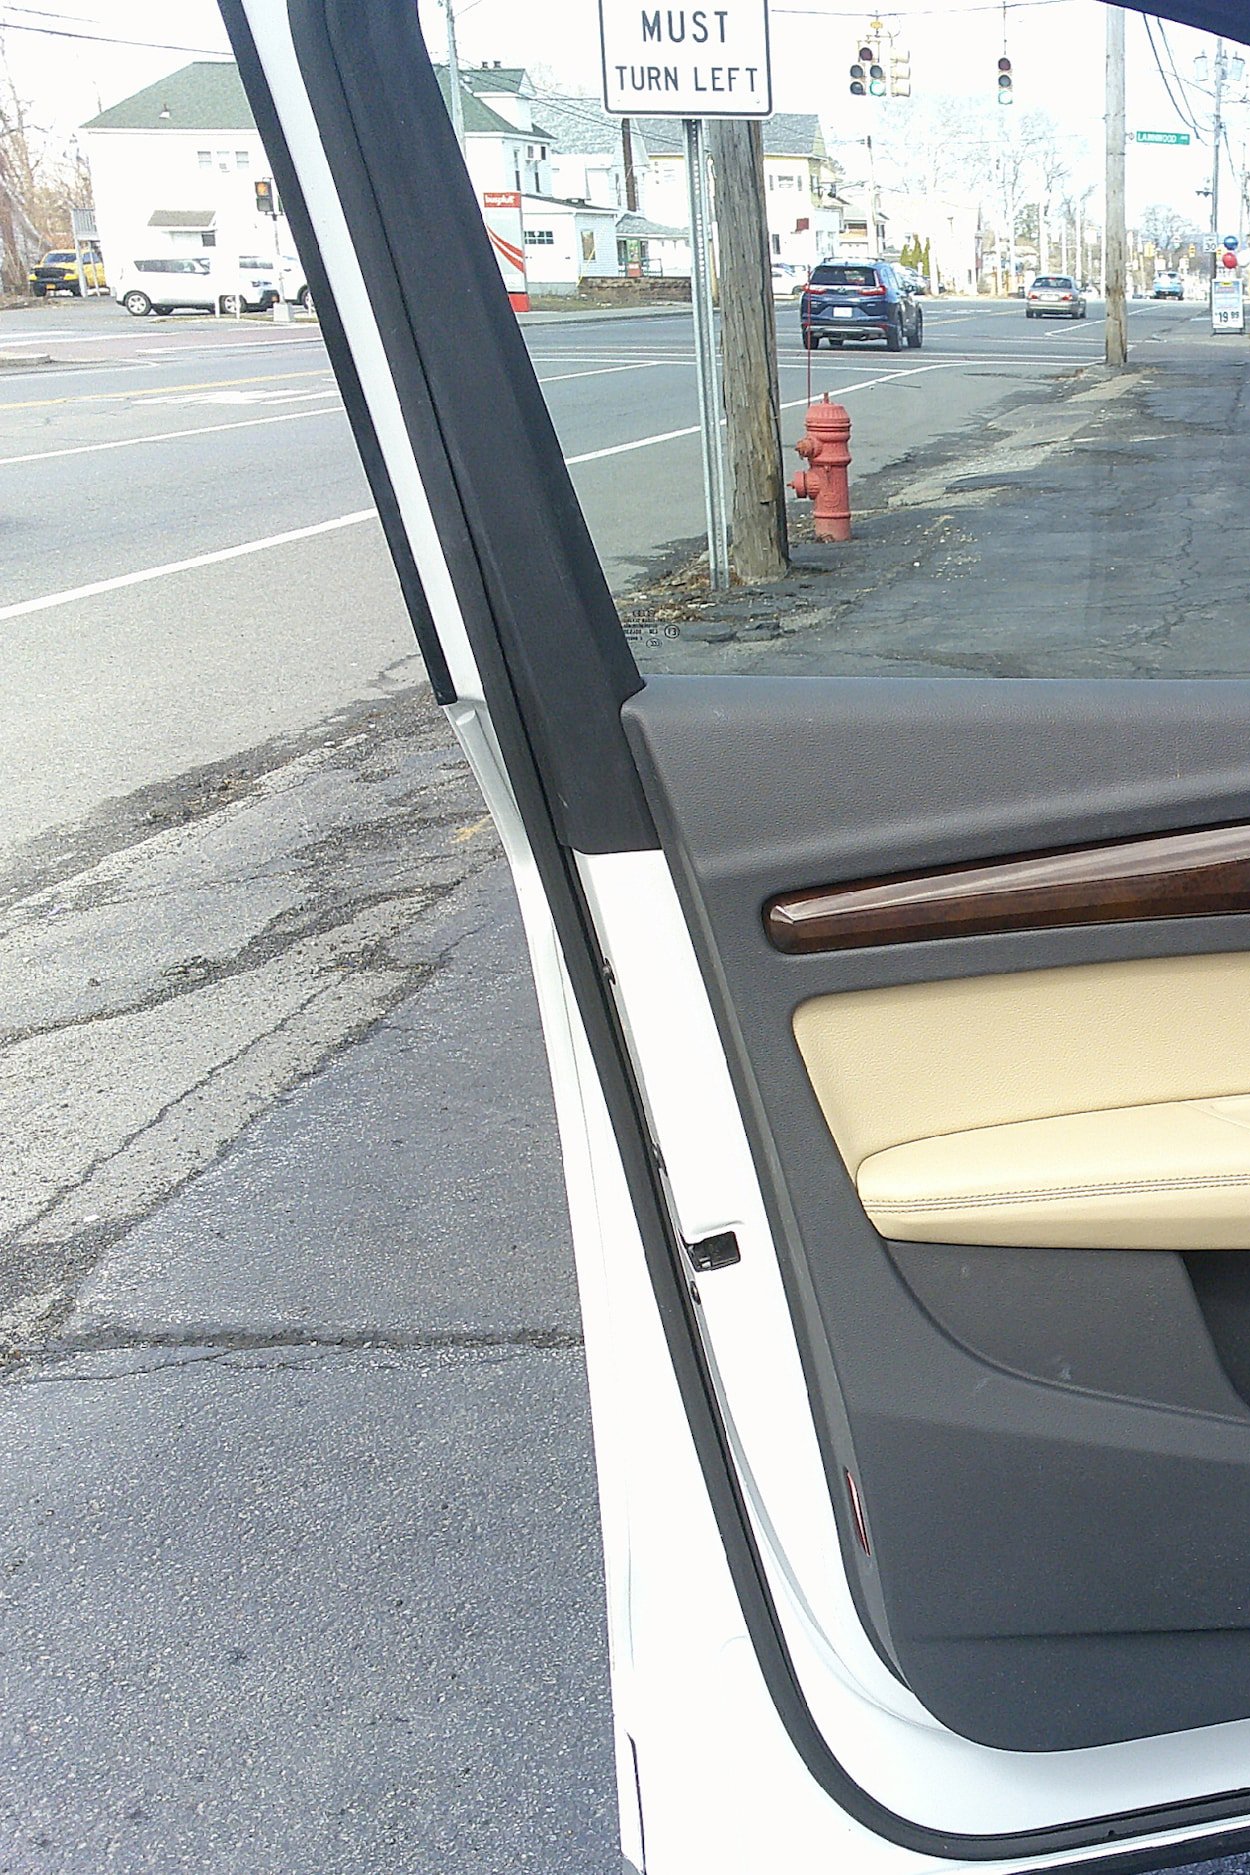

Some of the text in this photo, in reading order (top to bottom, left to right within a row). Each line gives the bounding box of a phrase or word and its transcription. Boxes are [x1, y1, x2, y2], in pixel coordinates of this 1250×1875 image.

[641, 10, 728, 43] MUST
[615, 66, 758, 92] TURN LEFT
